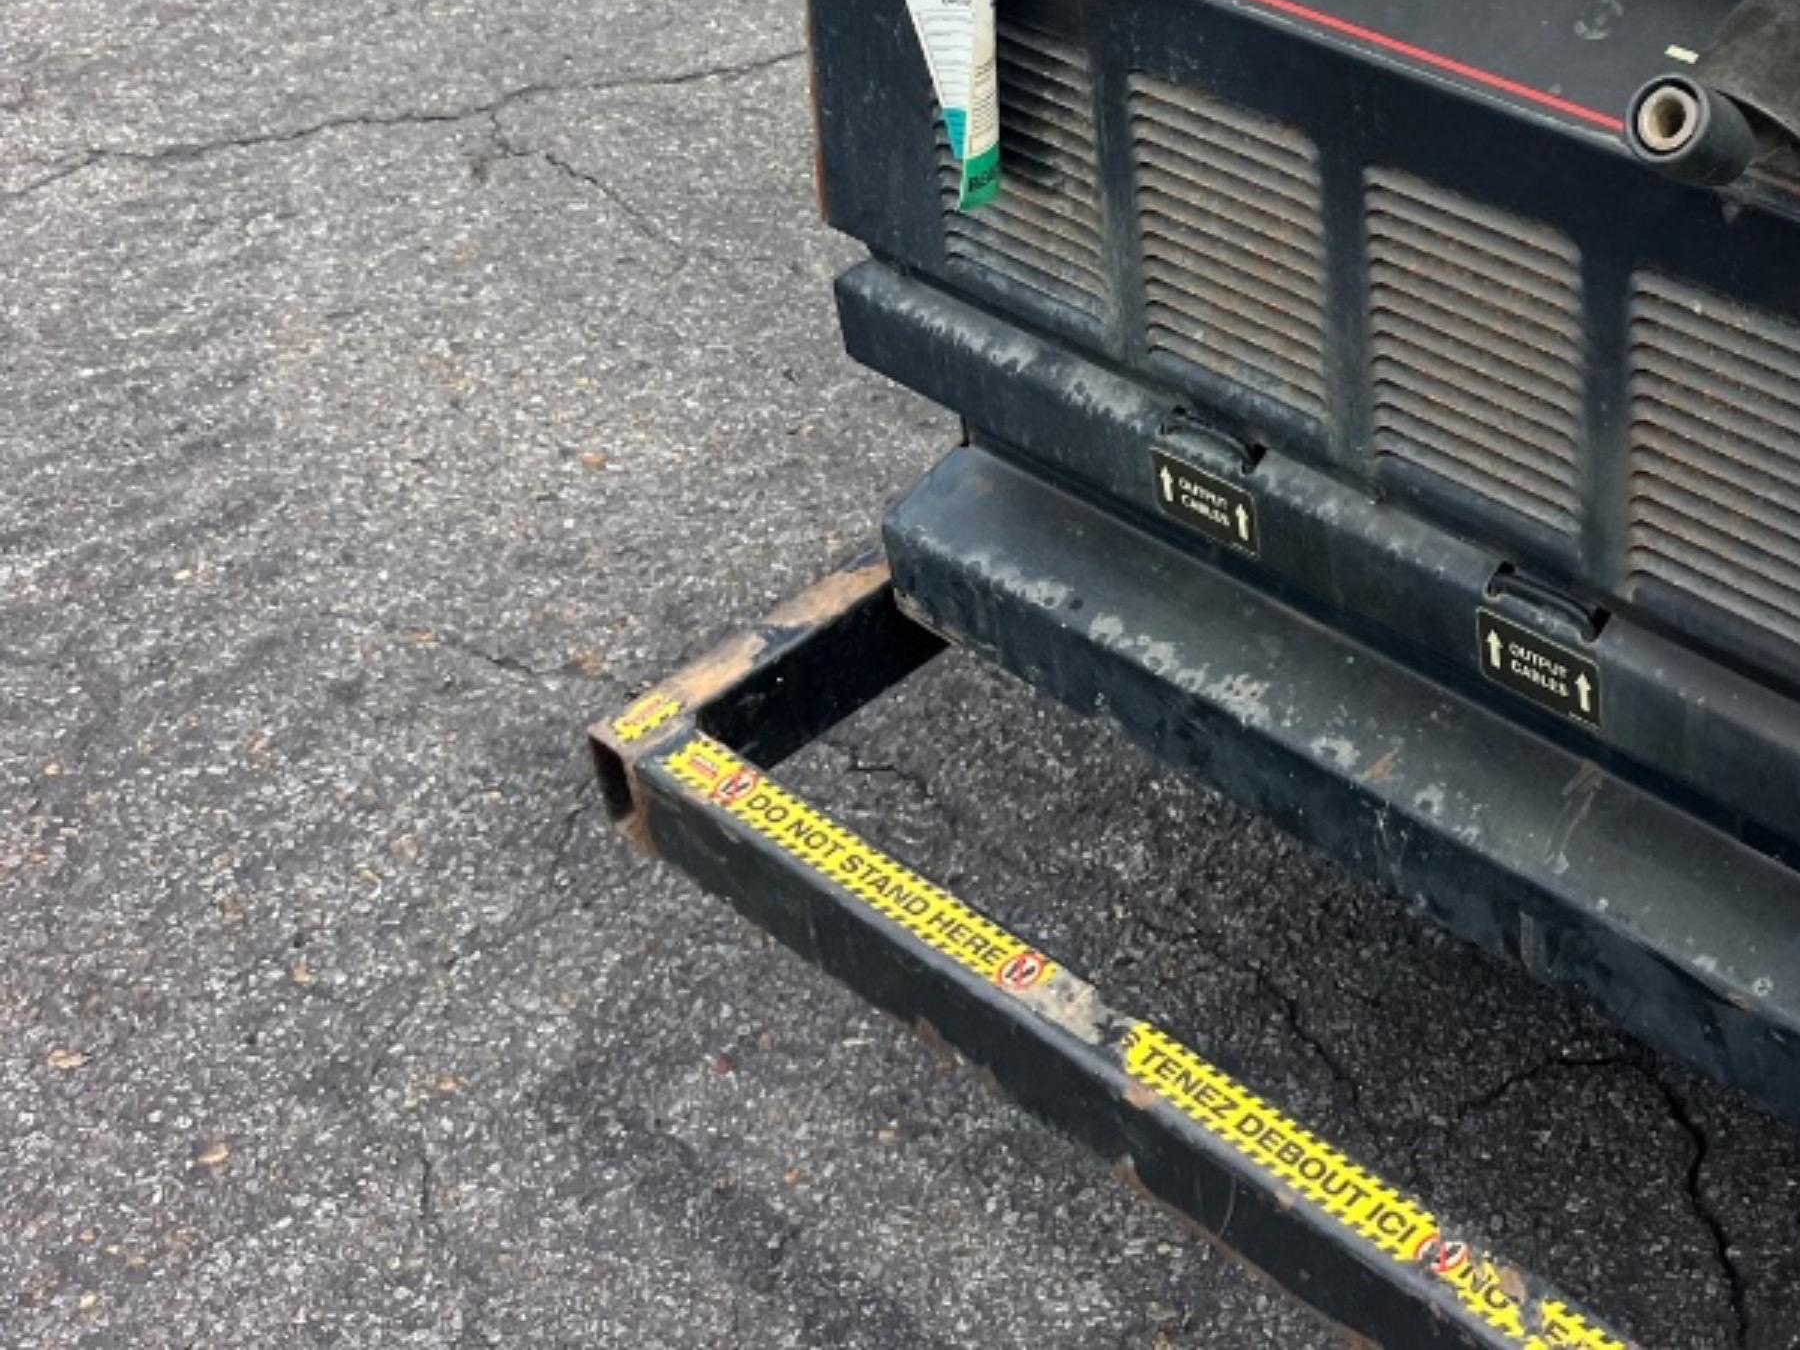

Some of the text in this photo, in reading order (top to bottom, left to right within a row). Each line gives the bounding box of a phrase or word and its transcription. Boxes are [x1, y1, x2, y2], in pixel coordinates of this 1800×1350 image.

[1177, 475, 1229, 510] OUTPUT
[1180, 492, 1231, 529] CABLES
[1507, 640, 1569, 680] OUTPUT
[1510, 658, 1571, 700] CABLES
[745, 790, 1009, 969] DO NOT STAND HERE
[1140, 1044, 1419, 1247] TENEZ DEBOUT ICI
